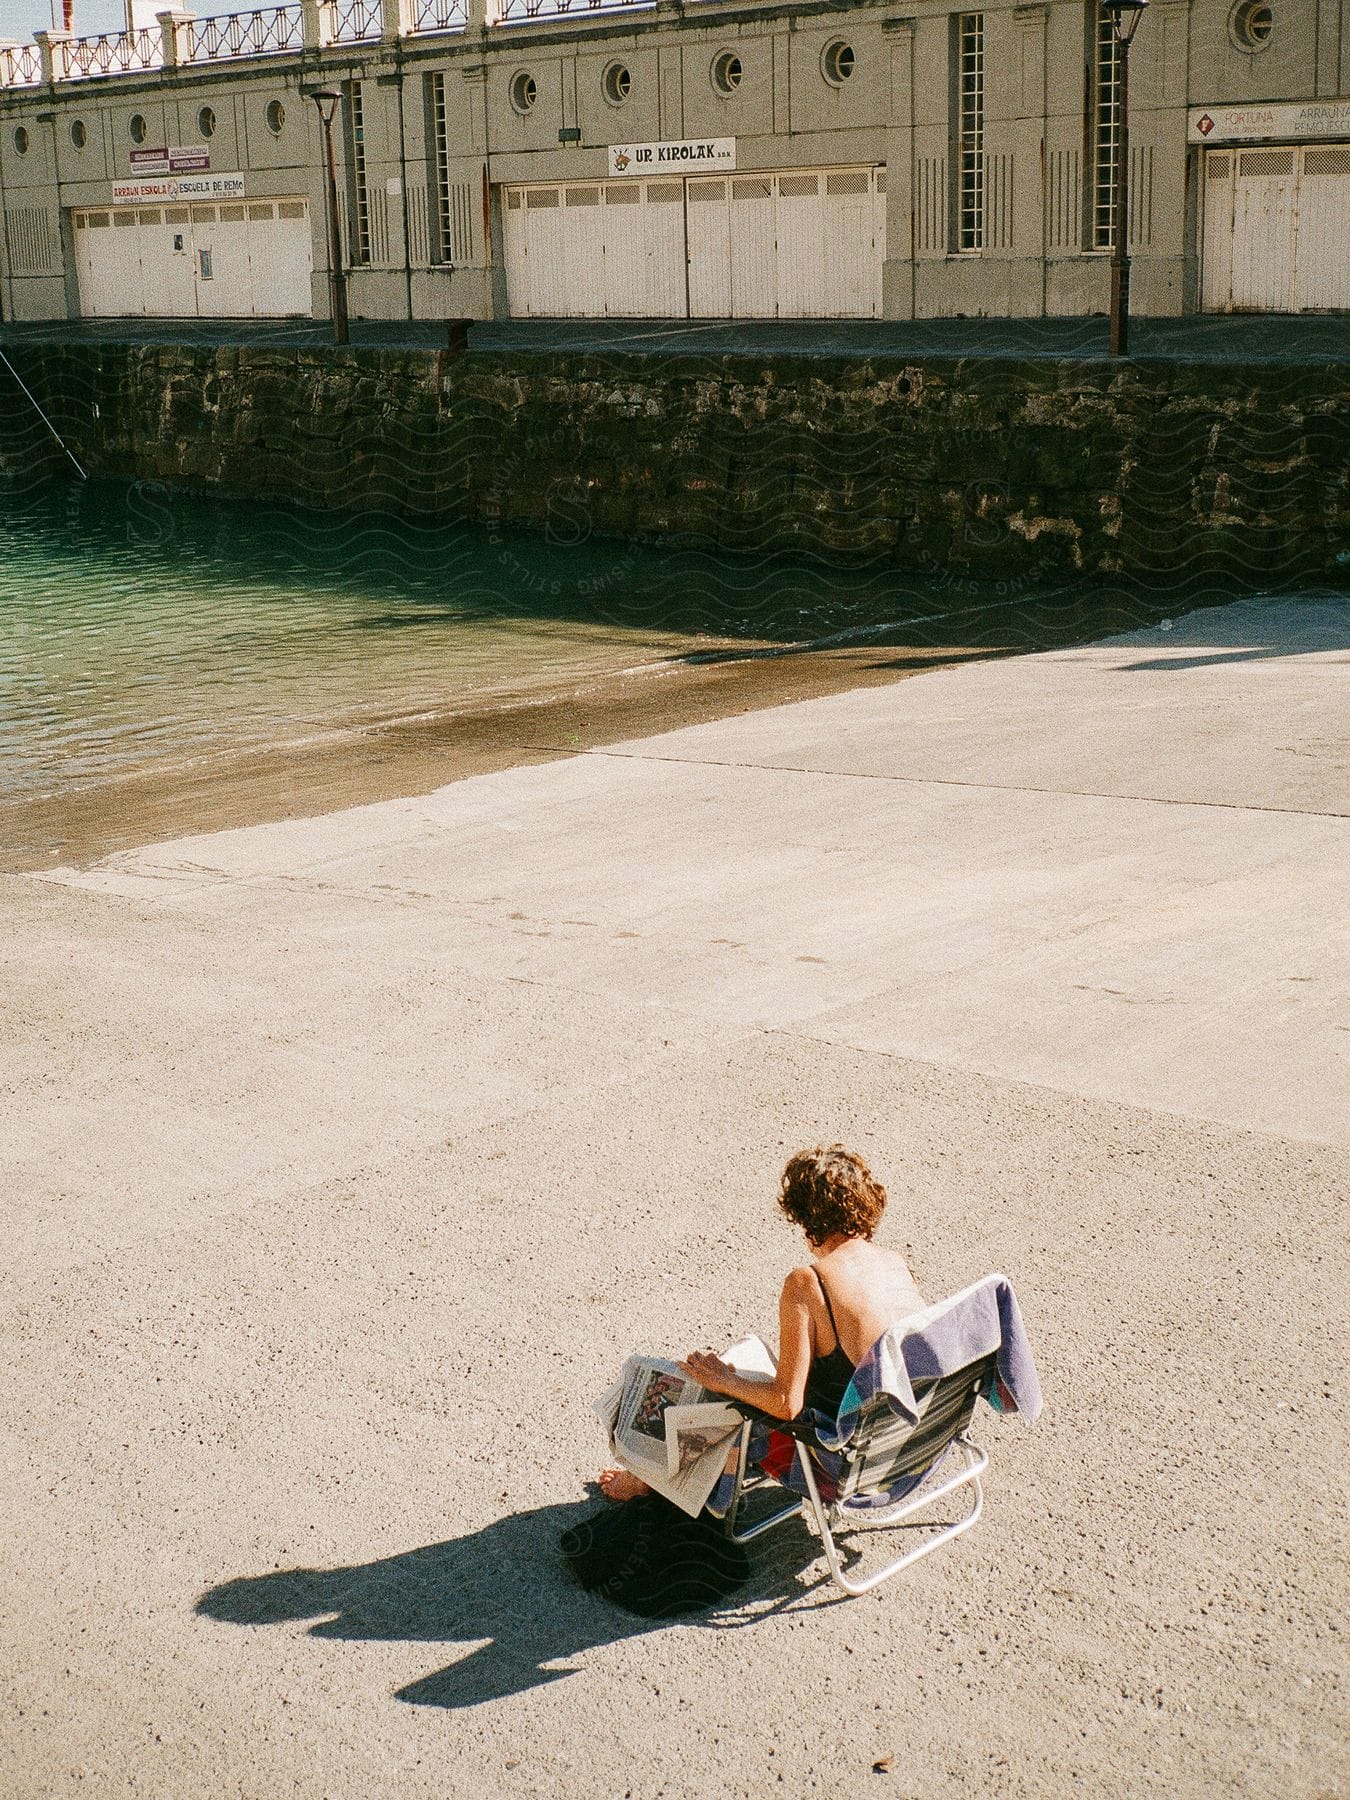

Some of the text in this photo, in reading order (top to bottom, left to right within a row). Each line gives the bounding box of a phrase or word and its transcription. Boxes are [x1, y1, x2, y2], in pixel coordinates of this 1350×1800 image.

[1225, 111, 1273, 125] FORTUNA
[636, 148, 653, 163] UR
[658, 144, 715, 161] KIROLAK
[141, 184, 167, 195] ESKOLA
[179, 182, 210, 193] ESCUELA
[213, 181, 222, 191] DE
